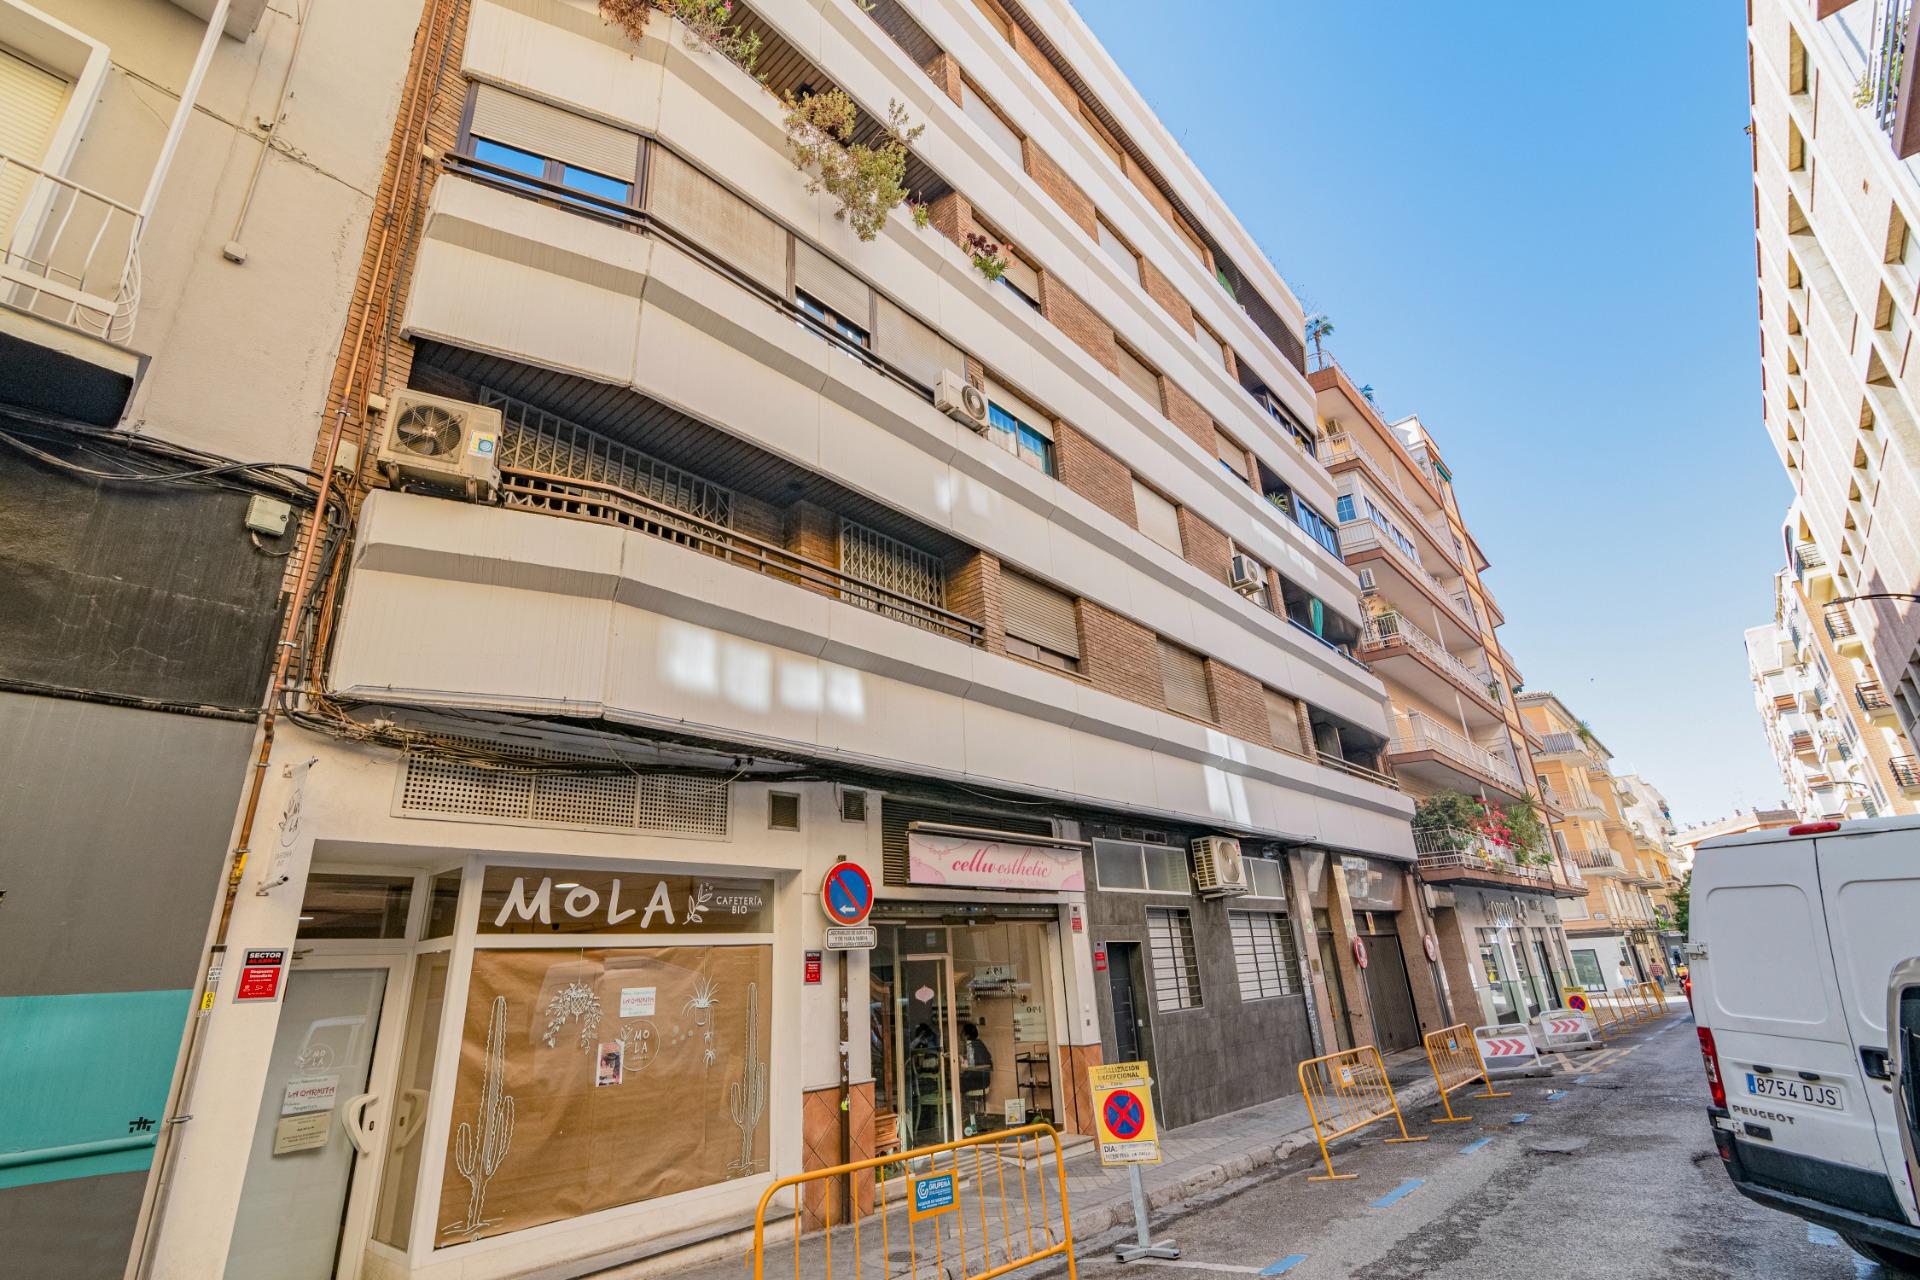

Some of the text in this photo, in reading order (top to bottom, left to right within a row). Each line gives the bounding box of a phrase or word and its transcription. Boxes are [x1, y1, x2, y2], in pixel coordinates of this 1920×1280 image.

[494, 877, 763, 928] MOLA CAFETERÍA
[731, 906, 748, 915] BIO
[1096, 1064, 1140, 1074] ALIZACIÓN
[1756, 1078, 1837, 1106] 8754 DJS
[1732, 1104, 1795, 1125] PEUGEOT
